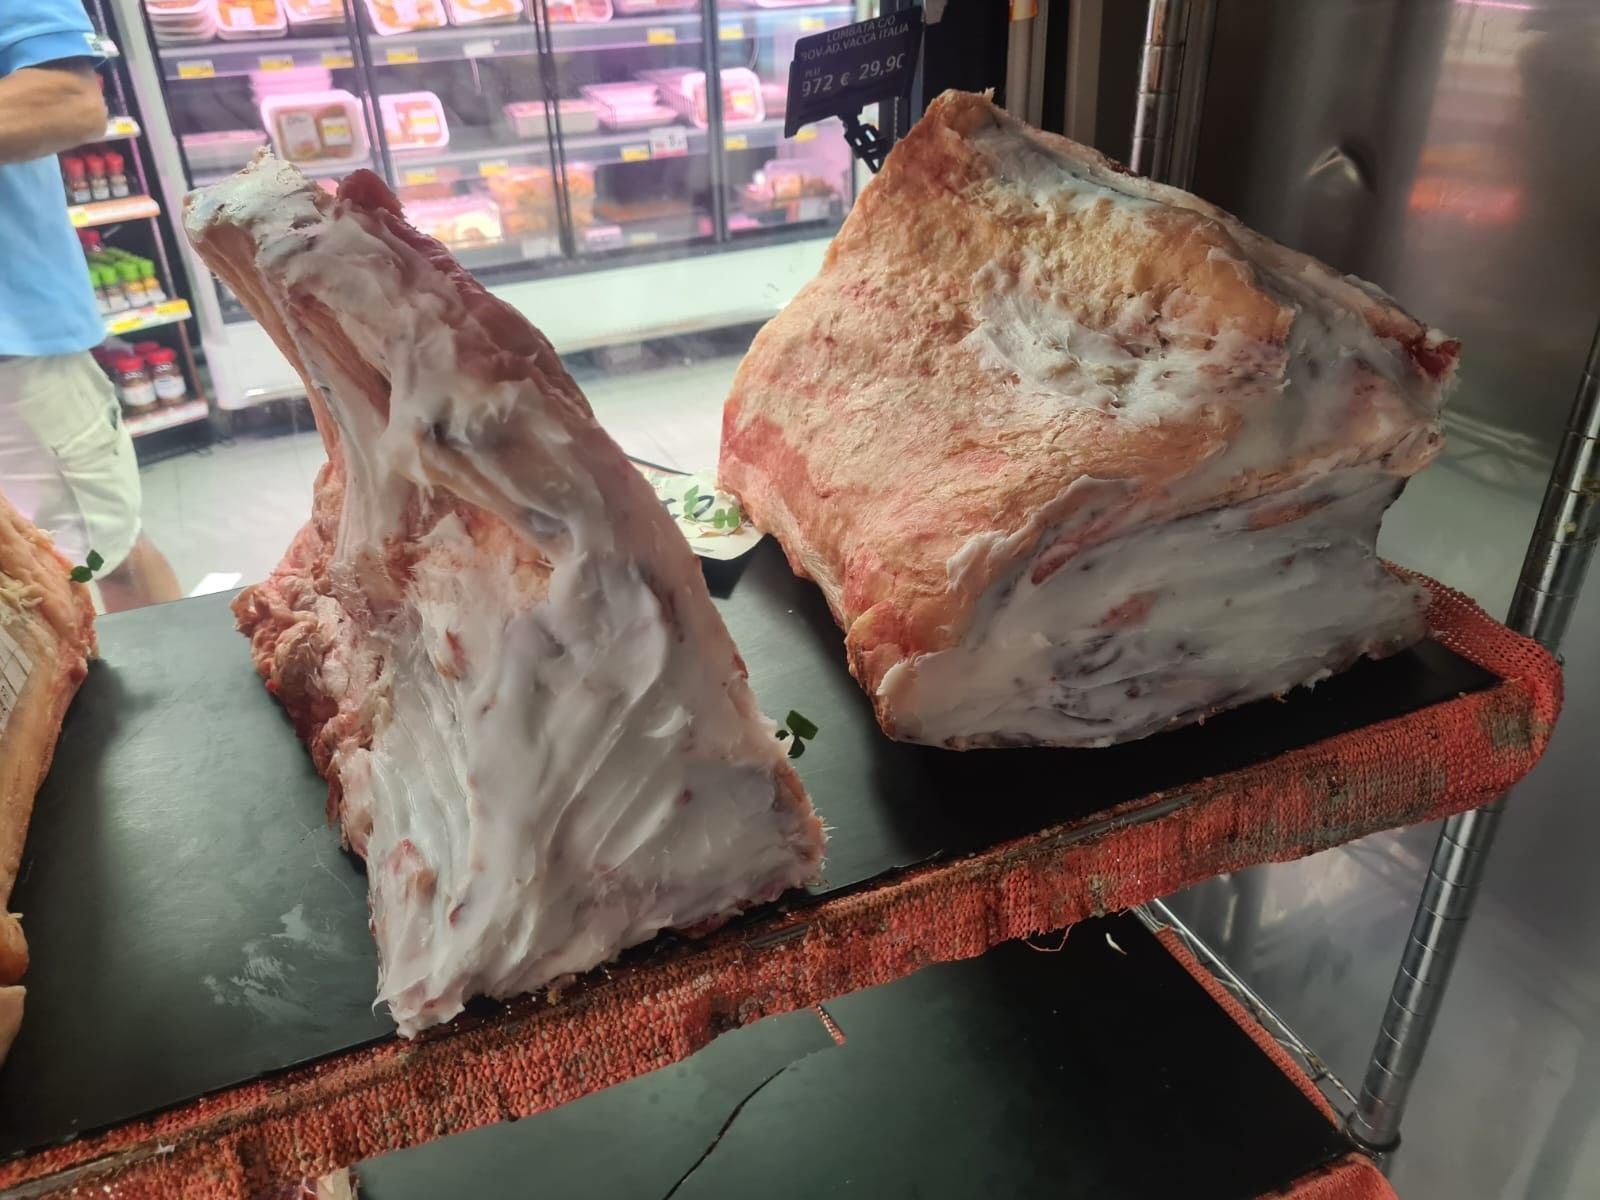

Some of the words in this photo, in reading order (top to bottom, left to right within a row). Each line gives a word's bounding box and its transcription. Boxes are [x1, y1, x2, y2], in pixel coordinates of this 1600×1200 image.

[827, 21, 875, 43] LOMBATA
[879, 23, 909, 40] ITALIA
[801, 74, 833, 97] 972
